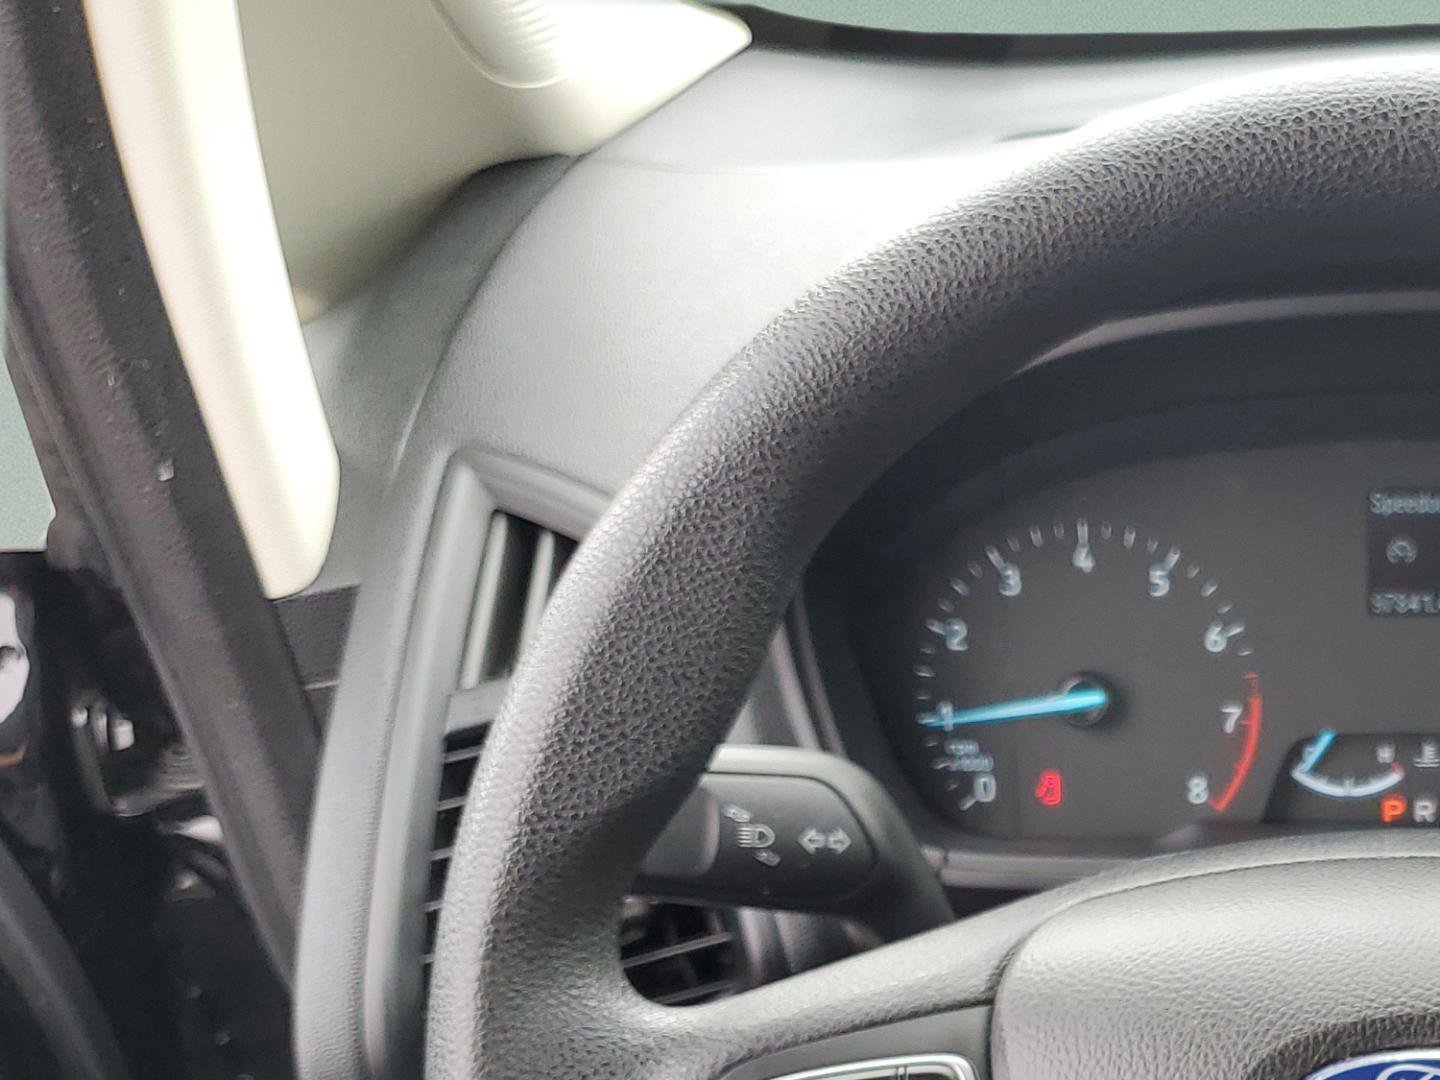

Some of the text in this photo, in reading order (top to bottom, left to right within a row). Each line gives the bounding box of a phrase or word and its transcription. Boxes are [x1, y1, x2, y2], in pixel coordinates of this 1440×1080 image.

[1072, 545, 1096, 573] 4
[1000, 561, 1022, 596] 3
[1149, 561, 1170, 597] 5
[945, 617, 968, 651] 2
[1204, 620, 1228, 652] 6
[1221, 702, 1243, 734] 7
[974, 772, 996, 802] 0
[1186, 773, 1209, 804] 8
[1381, 796, 1407, 823] P
[1413, 796, 1437, 823] R
